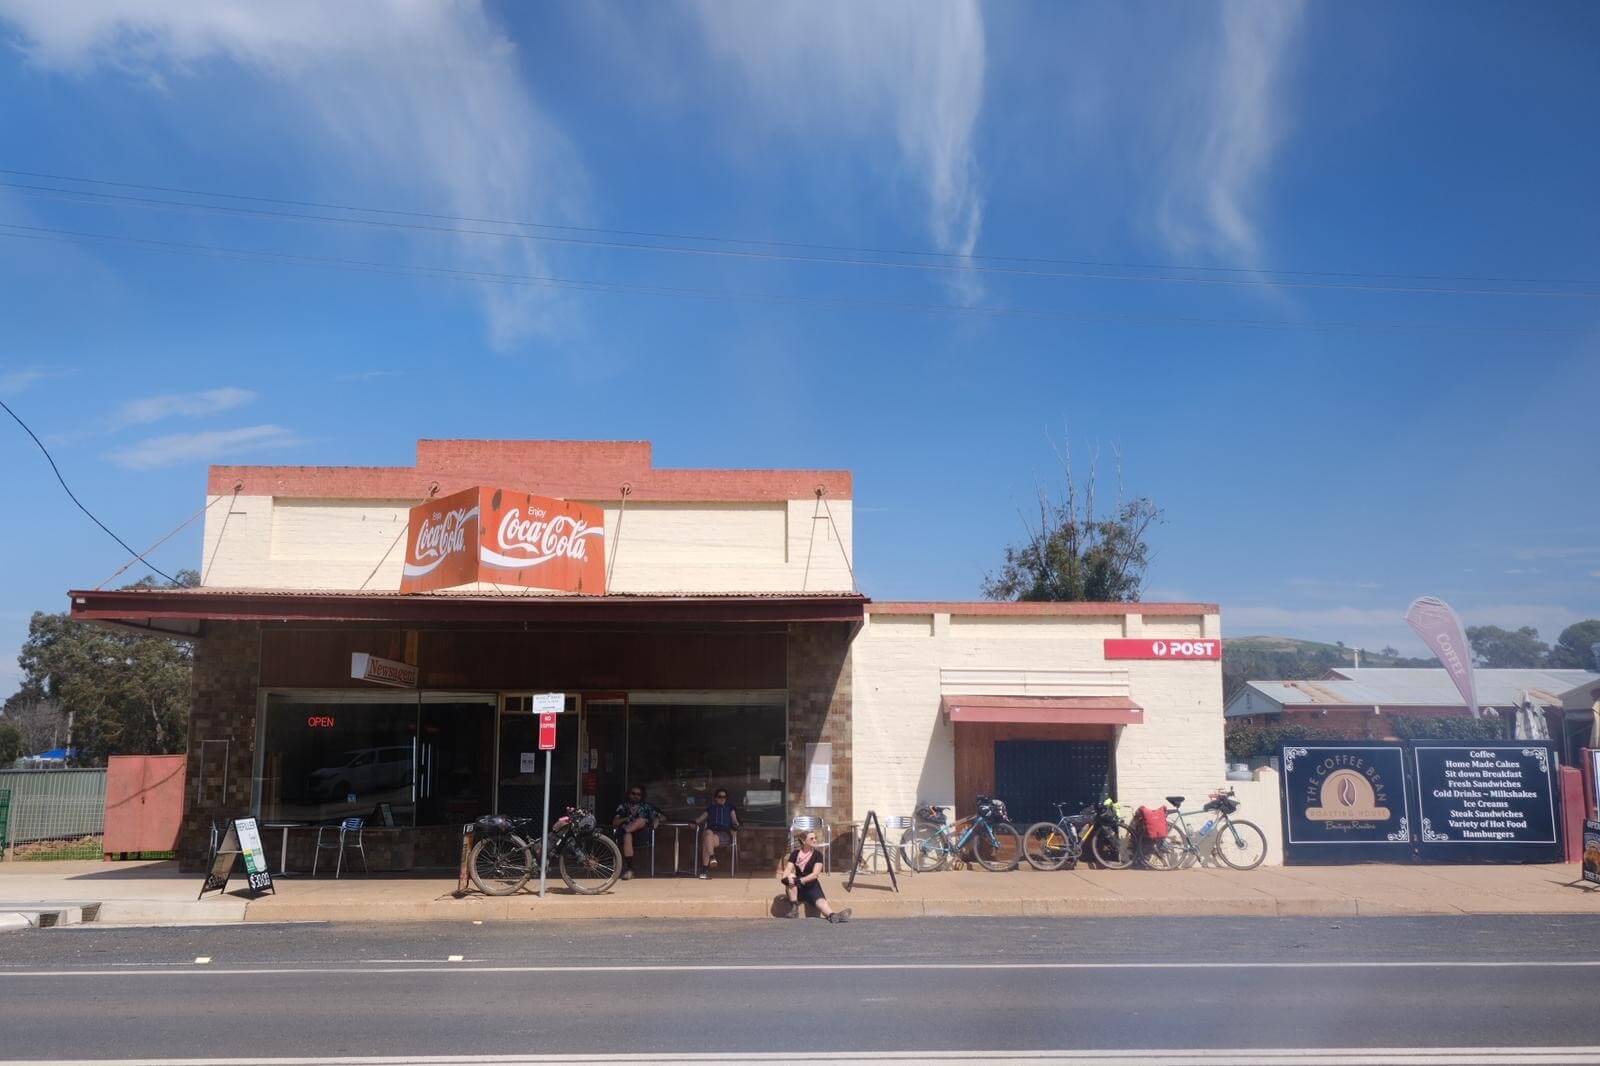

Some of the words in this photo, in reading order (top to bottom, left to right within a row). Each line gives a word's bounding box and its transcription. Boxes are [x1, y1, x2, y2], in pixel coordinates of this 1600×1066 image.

[528, 506, 547, 519] Enjoy
[497, 508, 588, 560] Coca-Cola
[1170, 642, 1215, 656] POST
[369, 658, 416, 682] Newsagent
[307, 716, 335, 728] OPEN
[1469, 750, 1496, 759] Coffee
[1445, 760, 1471, 768] Home
[1472, 760, 1494, 768] Made
[1495, 760, 1520, 768] Cakes
[1306, 777, 1319, 803] THE
[1316, 754, 1364, 776] COFFEE
[1366, 767, 1387, 802] BEAN
[1445, 770, 1457, 778] Sit
[1458, 770, 1481, 778] down
[1482, 770, 1522, 778] Breakfast
[1448, 780, 1472, 788] Fresh
[1473, 780, 1521, 788] Sandwiches
[1433, 790, 1452, 798] Cold
[1453, 790, 1482, 798] Drinks
[1490, 790, 1538, 798] Milkshakes
[1463, 800, 1477, 808] Ice
[1477, 800, 1509, 808] Creams
[1450, 810, 1474, 818] Steak
[1475, 810, 1524, 818] Sandwiches
[1448, 820, 1479, 829] Variety
[1479, 820, 1489, 828] of
[1490, 820, 1505, 828] Hot
[1506, 820, 1527, 828] Food
[1462, 830, 1515, 839] Hamburgers
